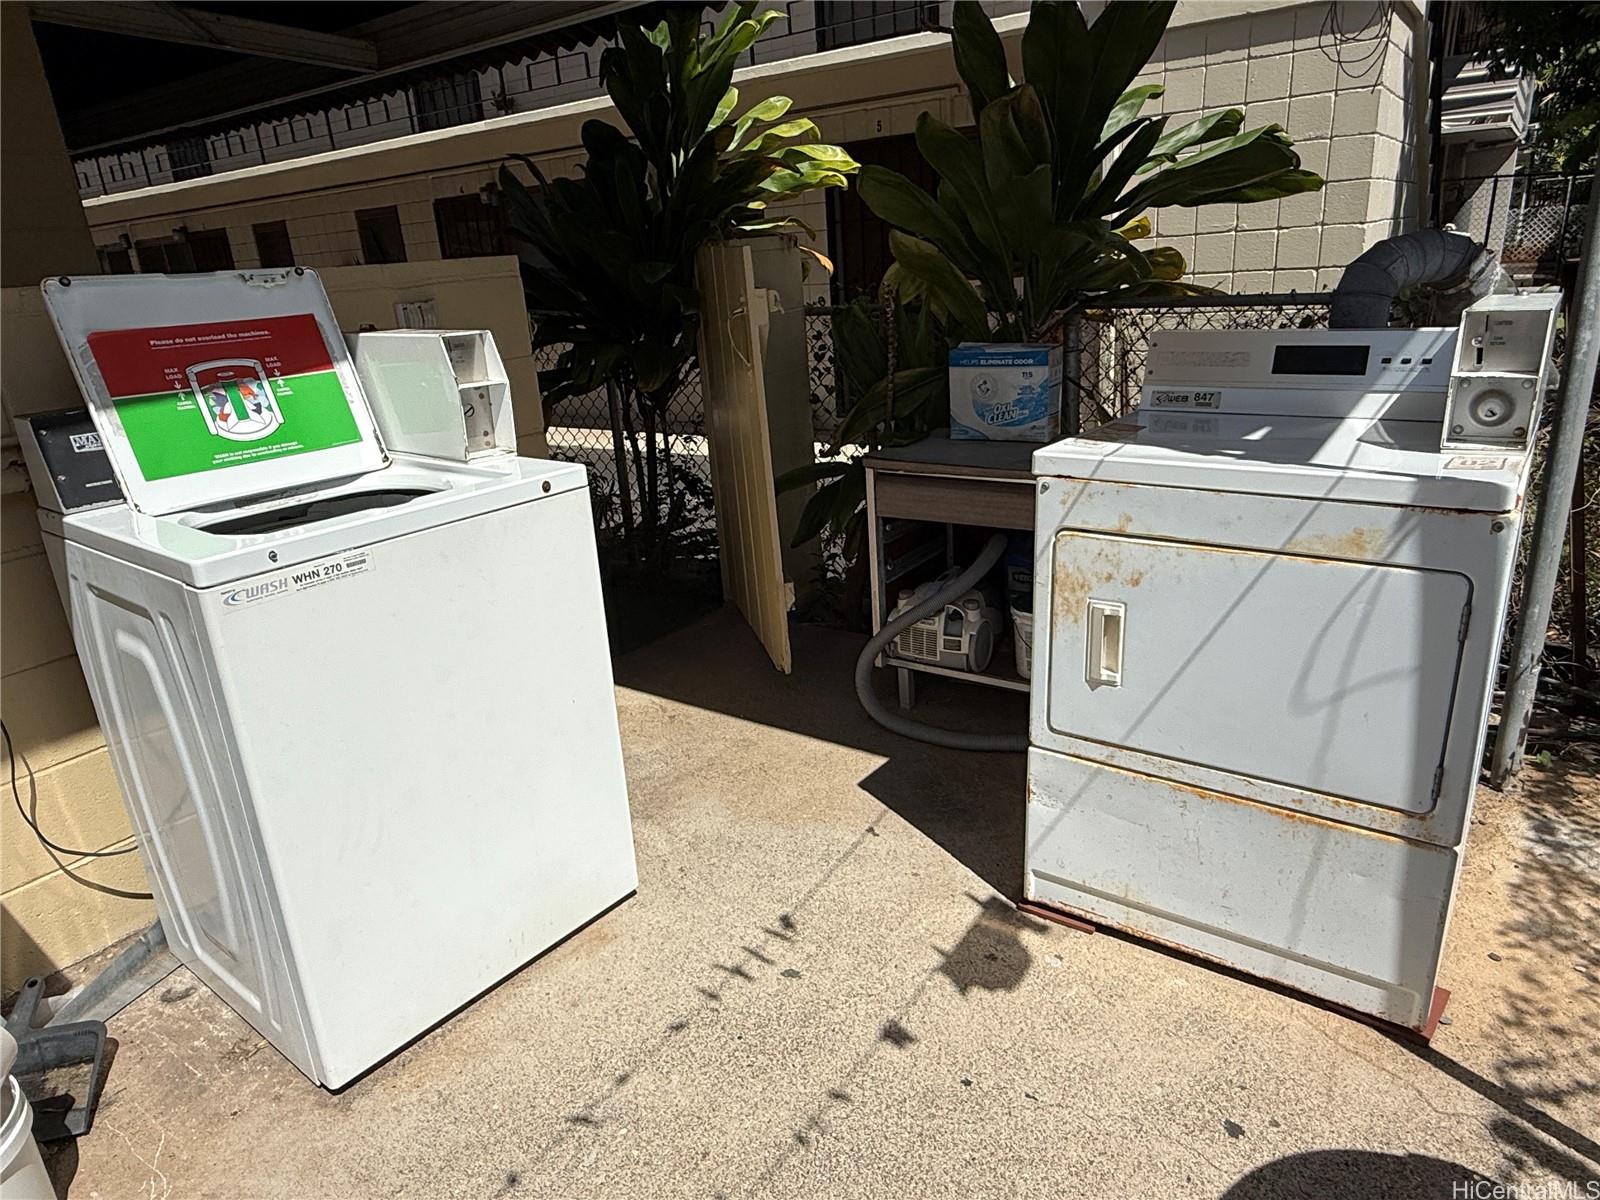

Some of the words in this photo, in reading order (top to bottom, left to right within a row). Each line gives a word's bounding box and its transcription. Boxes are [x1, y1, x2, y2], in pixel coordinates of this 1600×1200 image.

[876, 119, 883, 133] 5
[1194, 392, 1215, 402] 847
[994, 403, 1011, 413] OXI
[988, 410, 1016, 424] CLEAN
[245, 578, 288, 599] WASH
[292, 569, 321, 585] WHN
[323, 563, 343, 576] 270
